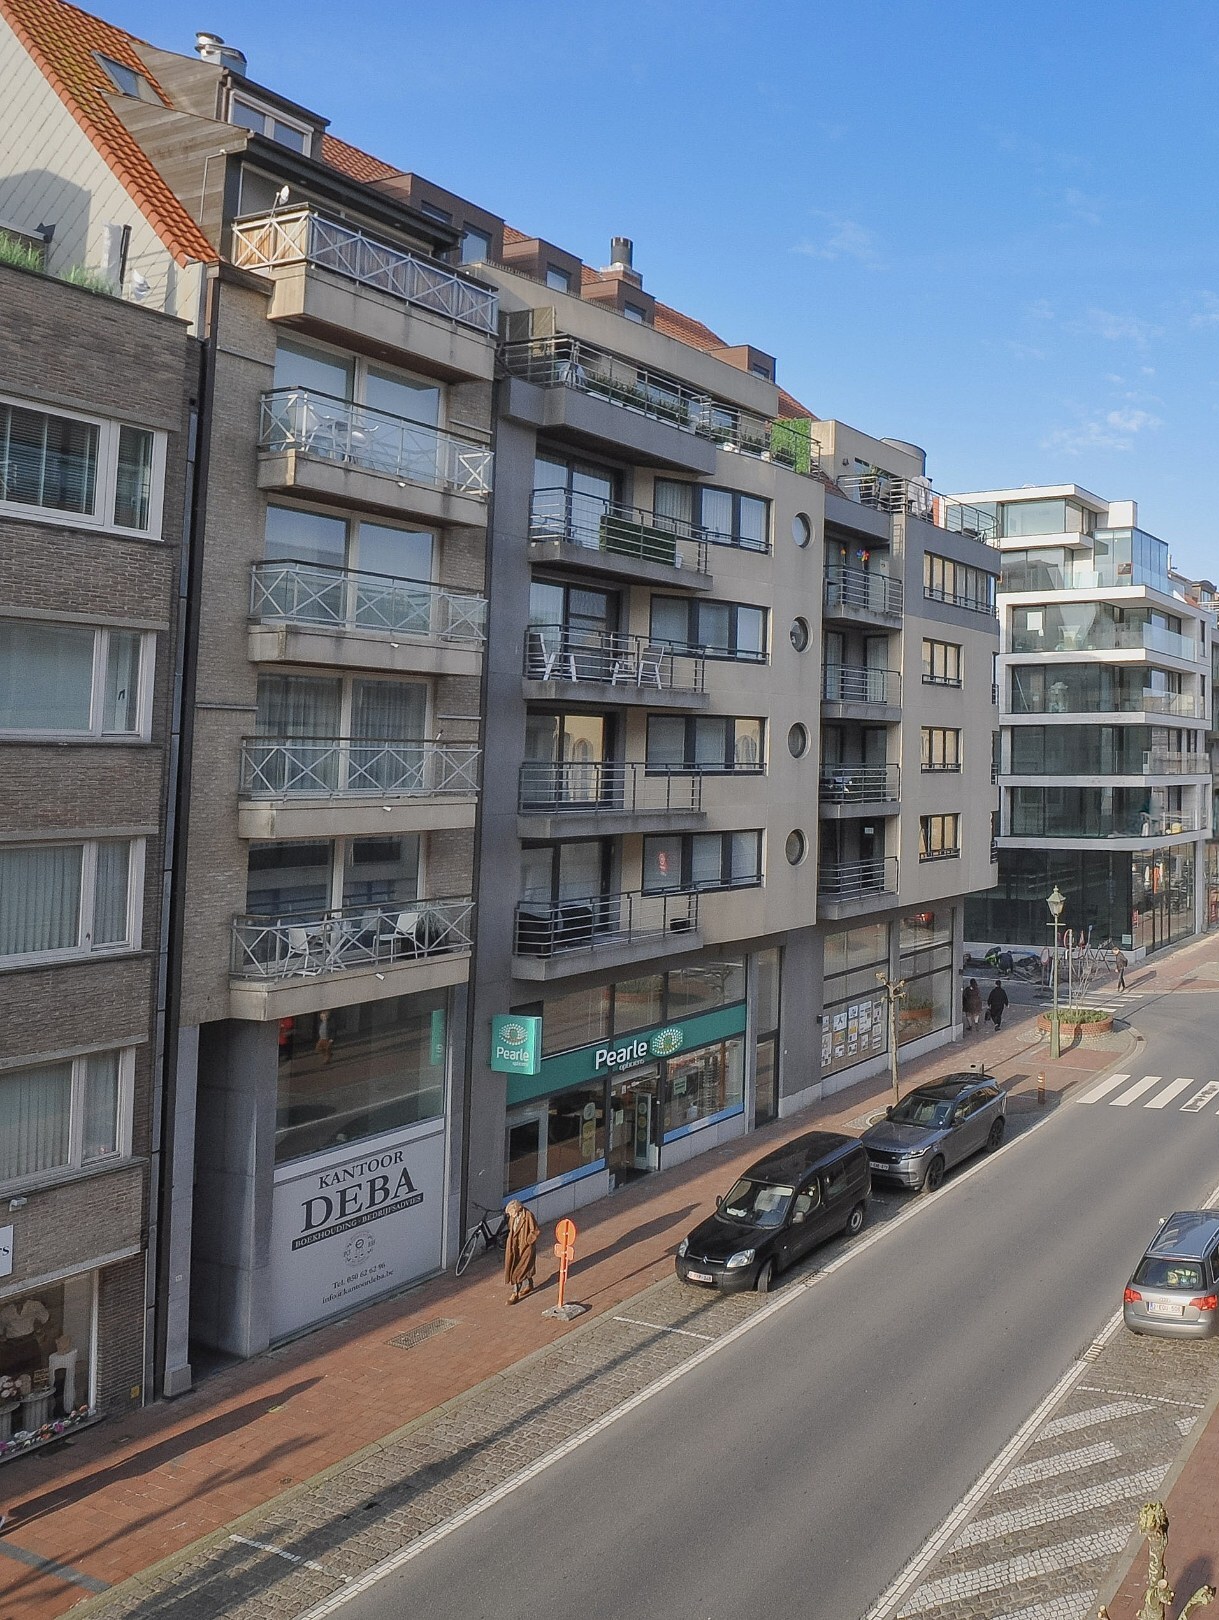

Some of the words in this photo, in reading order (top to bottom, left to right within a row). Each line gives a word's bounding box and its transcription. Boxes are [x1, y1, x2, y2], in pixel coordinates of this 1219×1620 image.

[496, 1046, 529, 1062] Pearle
[595, 1039, 648, 1070] Pearle
[318, 1150, 404, 1190] KANTOOR
[300, 1166, 418, 1234] DEBA
[295, 1220, 357, 1248] BOEKHOUDING
[362, 1196, 422, 1223] BEDRIJFSADVIES
